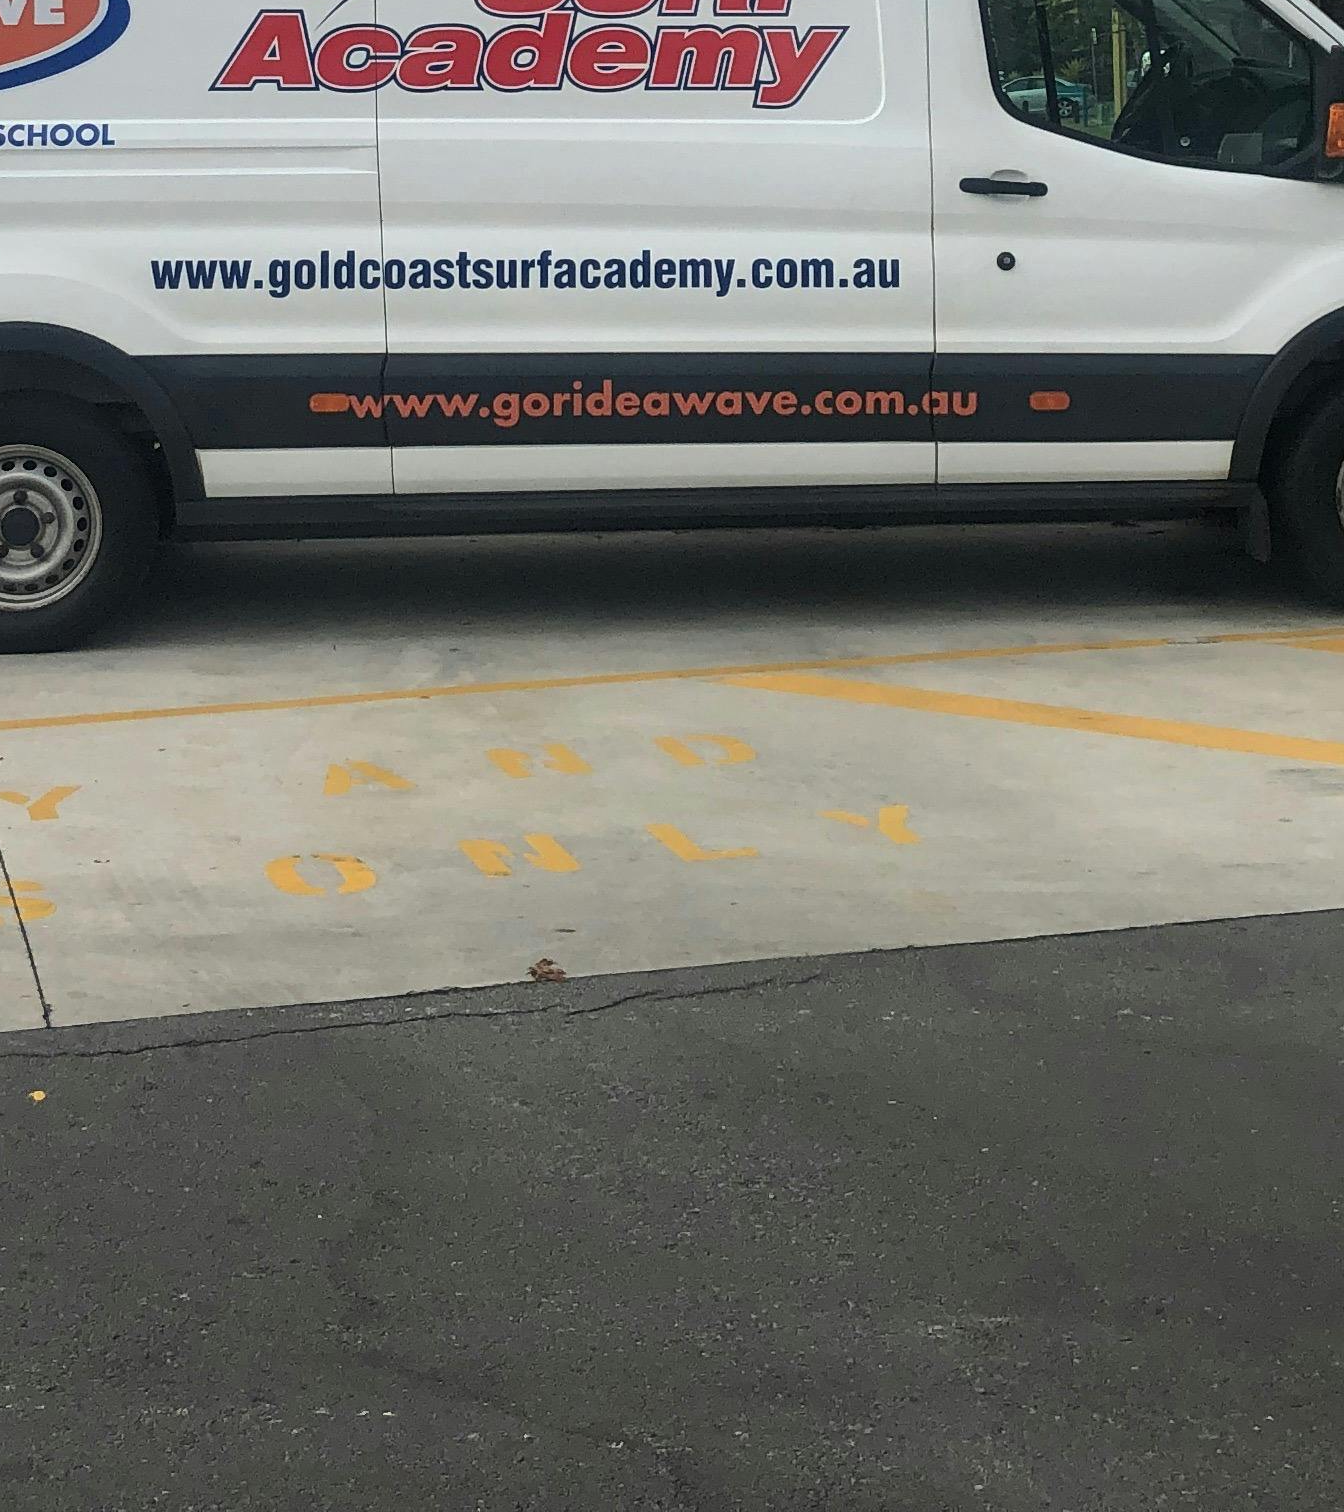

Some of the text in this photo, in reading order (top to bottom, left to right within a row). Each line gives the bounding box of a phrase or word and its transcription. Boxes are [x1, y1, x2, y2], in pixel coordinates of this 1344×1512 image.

[208, 8, 850, 110] Academy
[150, 249, 901, 298] www.goldcoastsurfacademy.com.au
[347, 380, 979, 428] www.gorideawave.com.au
[321, 733, 758, 796] AND
[263, 803, 922, 897] ONLY
